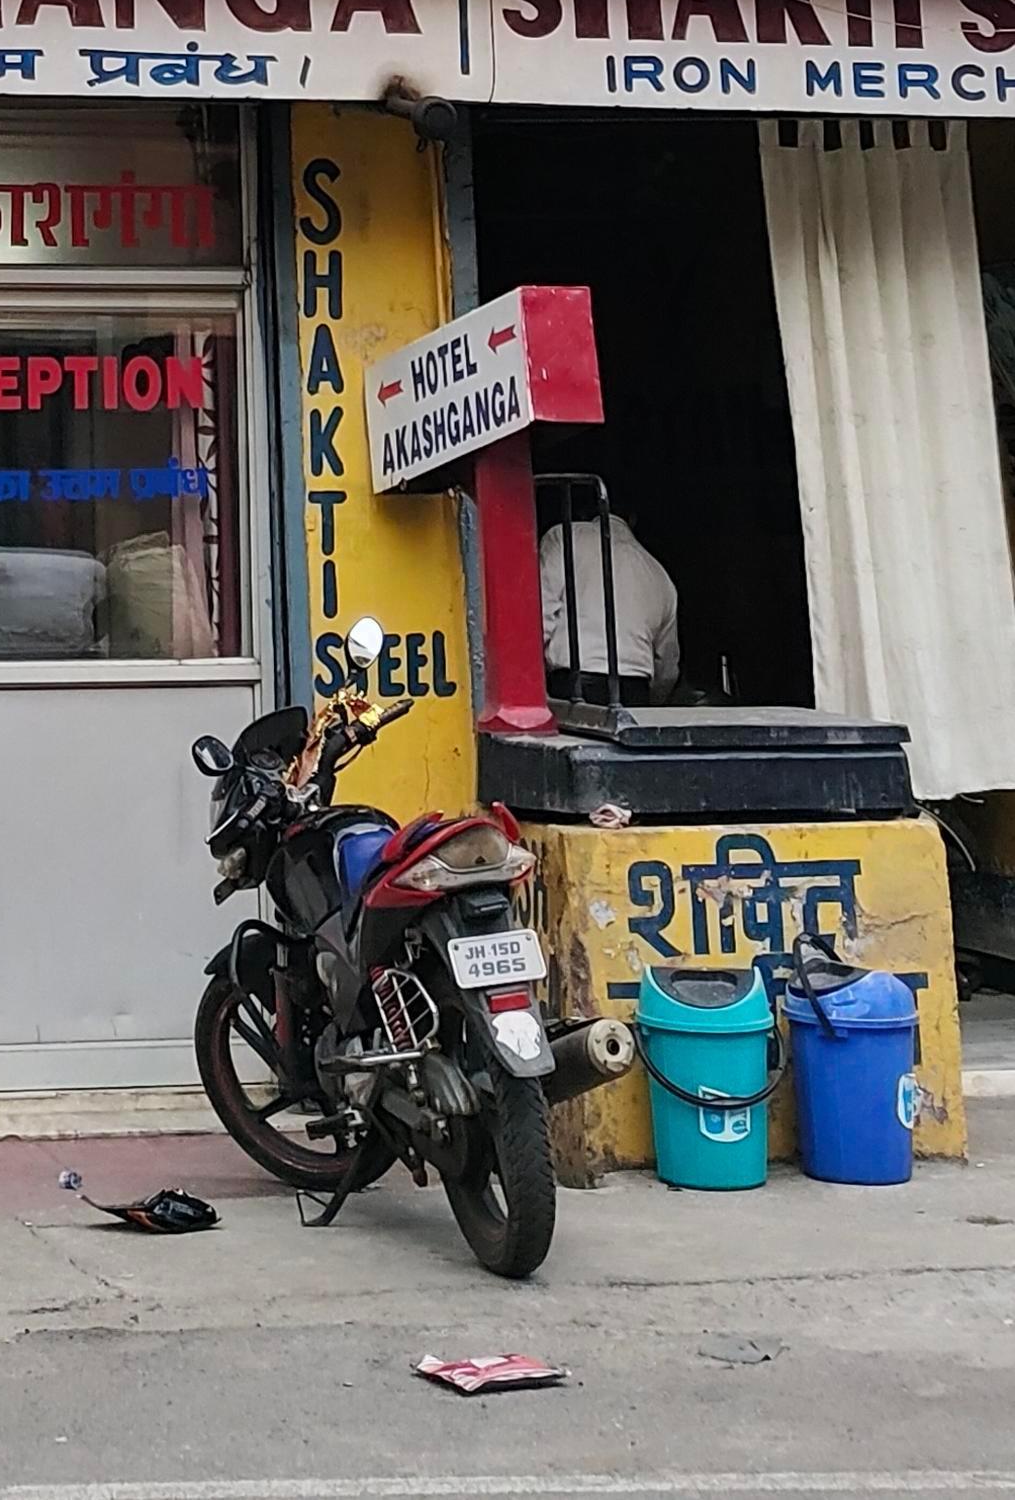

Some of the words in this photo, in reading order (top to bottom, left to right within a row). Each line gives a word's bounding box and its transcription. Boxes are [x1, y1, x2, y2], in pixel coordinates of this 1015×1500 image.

[79, 41, 278, 88] प्रबंध
[606, 55, 756, 93] IRON
[298, 157, 348, 620] SHAKTI
[411, 332, 478, 403] HOTEL
[382, 375, 521, 477] AKASHGANGA
[314, 629, 457, 699] SEEL
[468, 957, 526, 978] 4965
